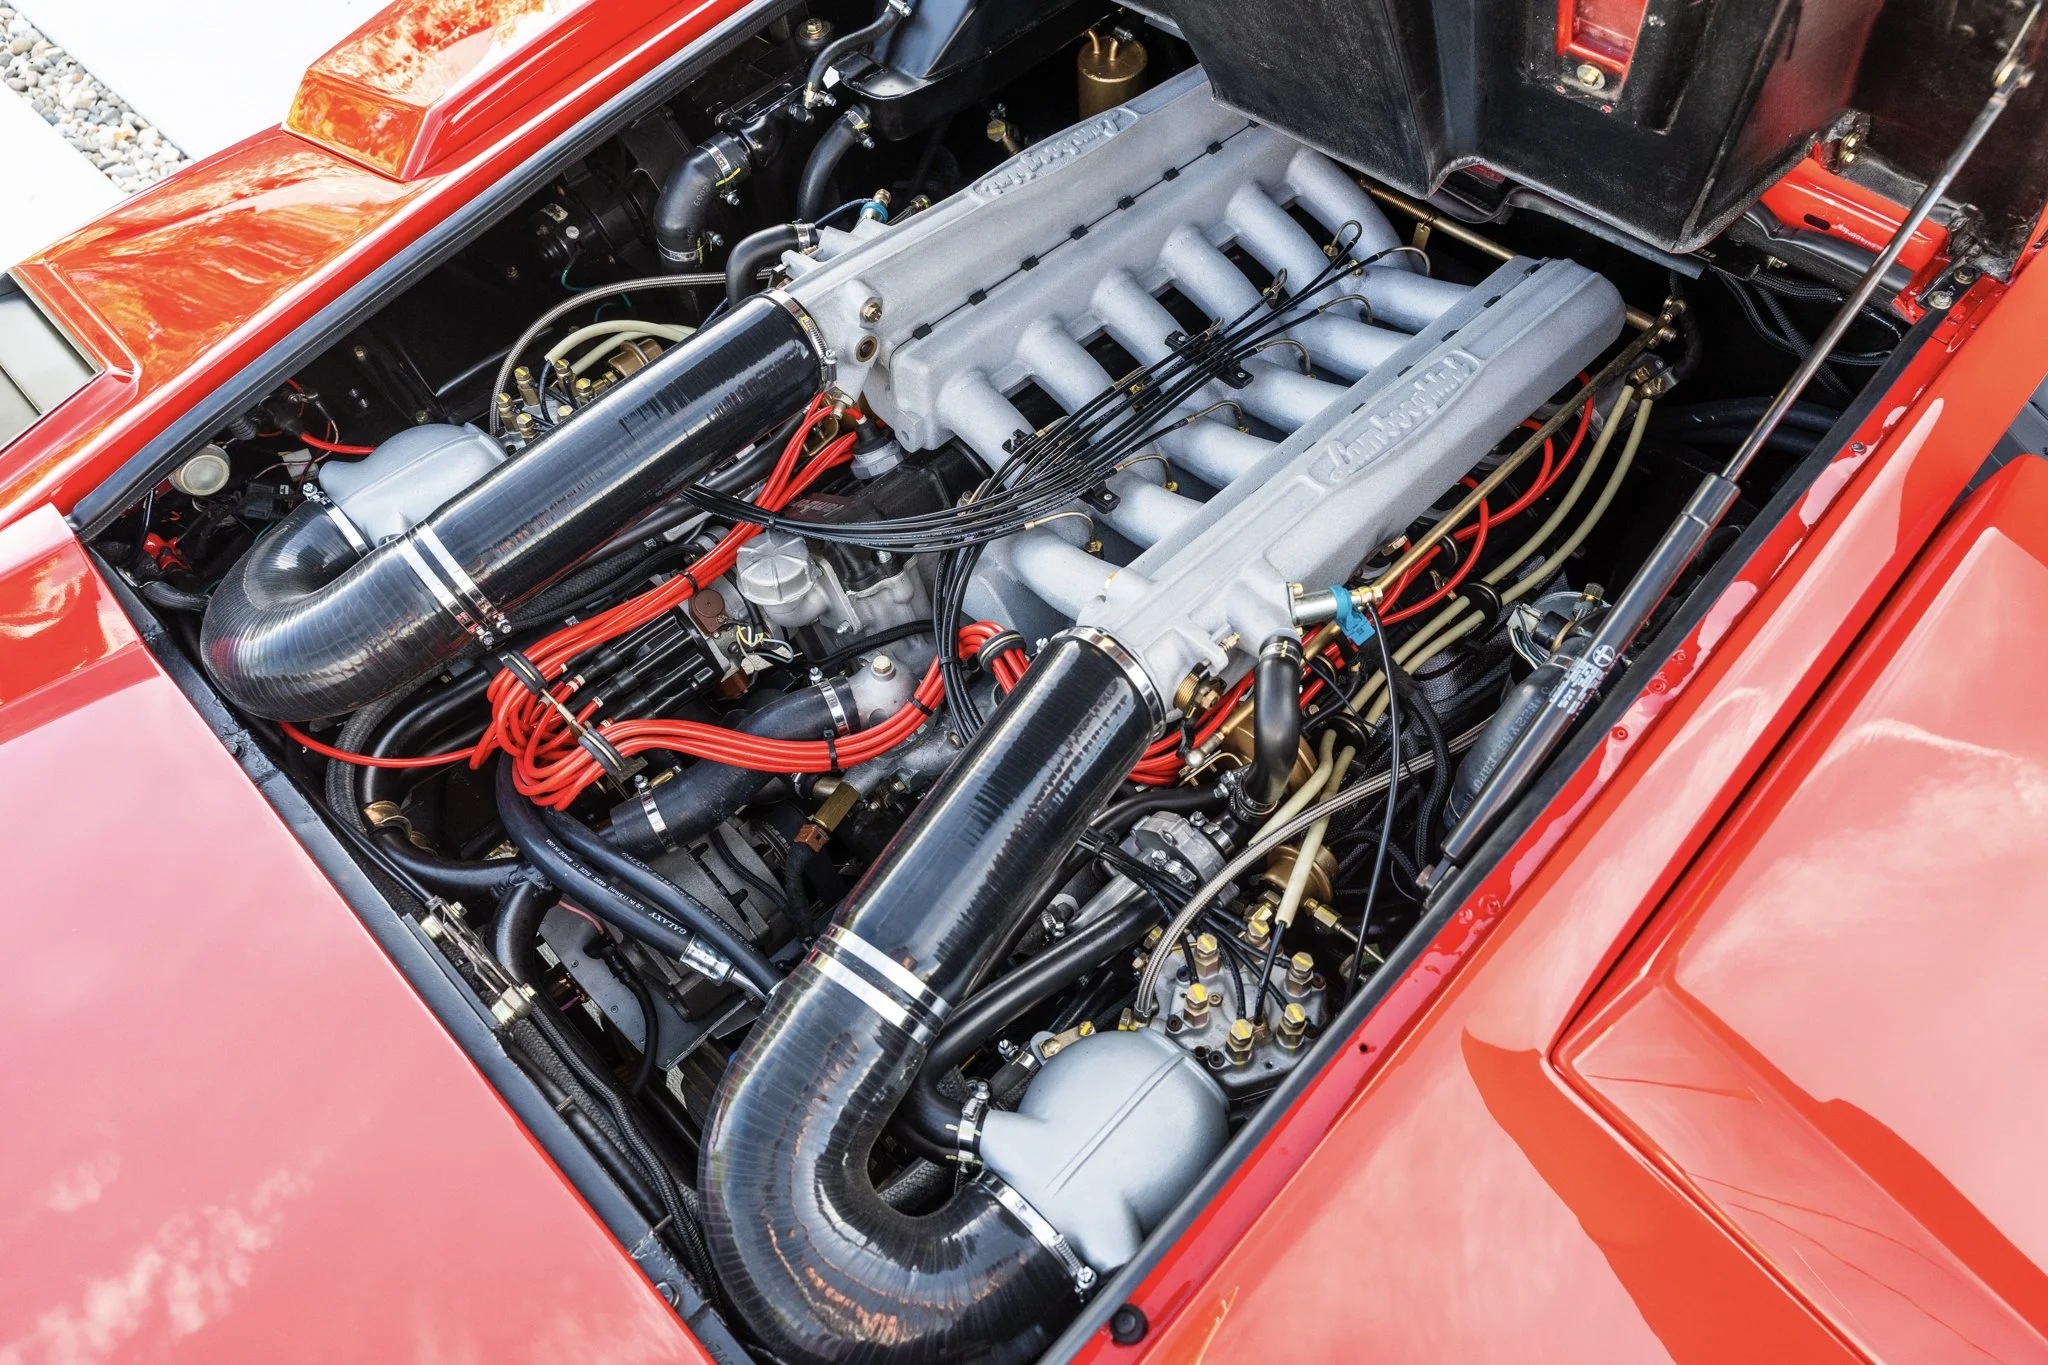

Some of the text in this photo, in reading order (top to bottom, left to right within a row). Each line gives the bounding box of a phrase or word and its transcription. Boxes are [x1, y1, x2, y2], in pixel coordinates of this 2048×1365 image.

[1326, 355, 1470, 482] Lamborghini
[545, 837, 556, 848] USA
[552, 844, 561, 853] IN
[557, 849, 574, 863] MADE
[578, 865, 592, 877] SIZE
[606, 884, 629, 901] (13mm)
[647, 910, 688, 936] GALAXY
